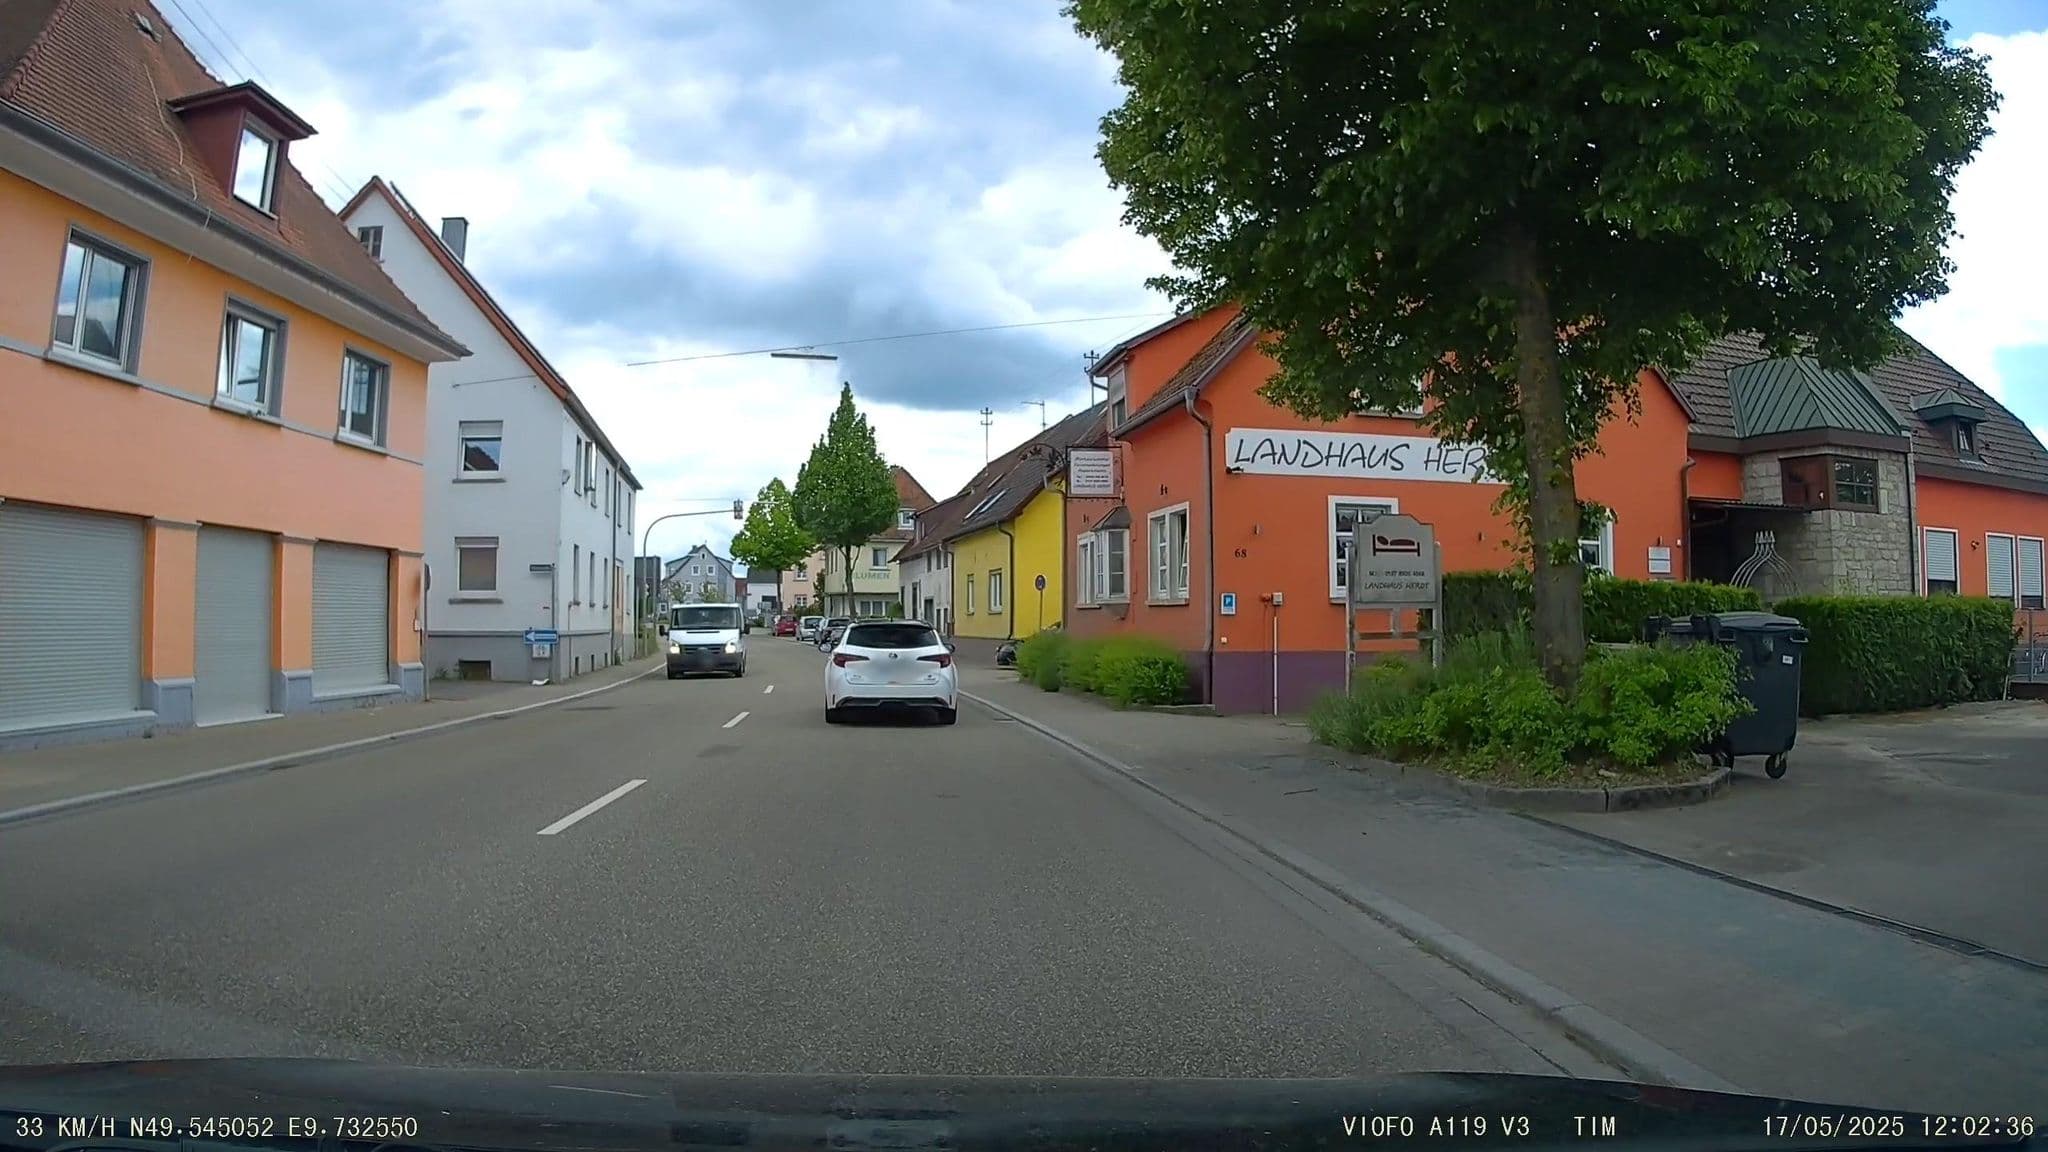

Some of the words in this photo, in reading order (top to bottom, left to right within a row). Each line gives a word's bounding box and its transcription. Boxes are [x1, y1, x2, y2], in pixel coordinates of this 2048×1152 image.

[1234, 437, 1410, 472] LANDHAUS
[1423, 446, 1487, 476] HER
[1234, 547, 1248, 558] 68
[853, 571, 891, 580] LUMEN
